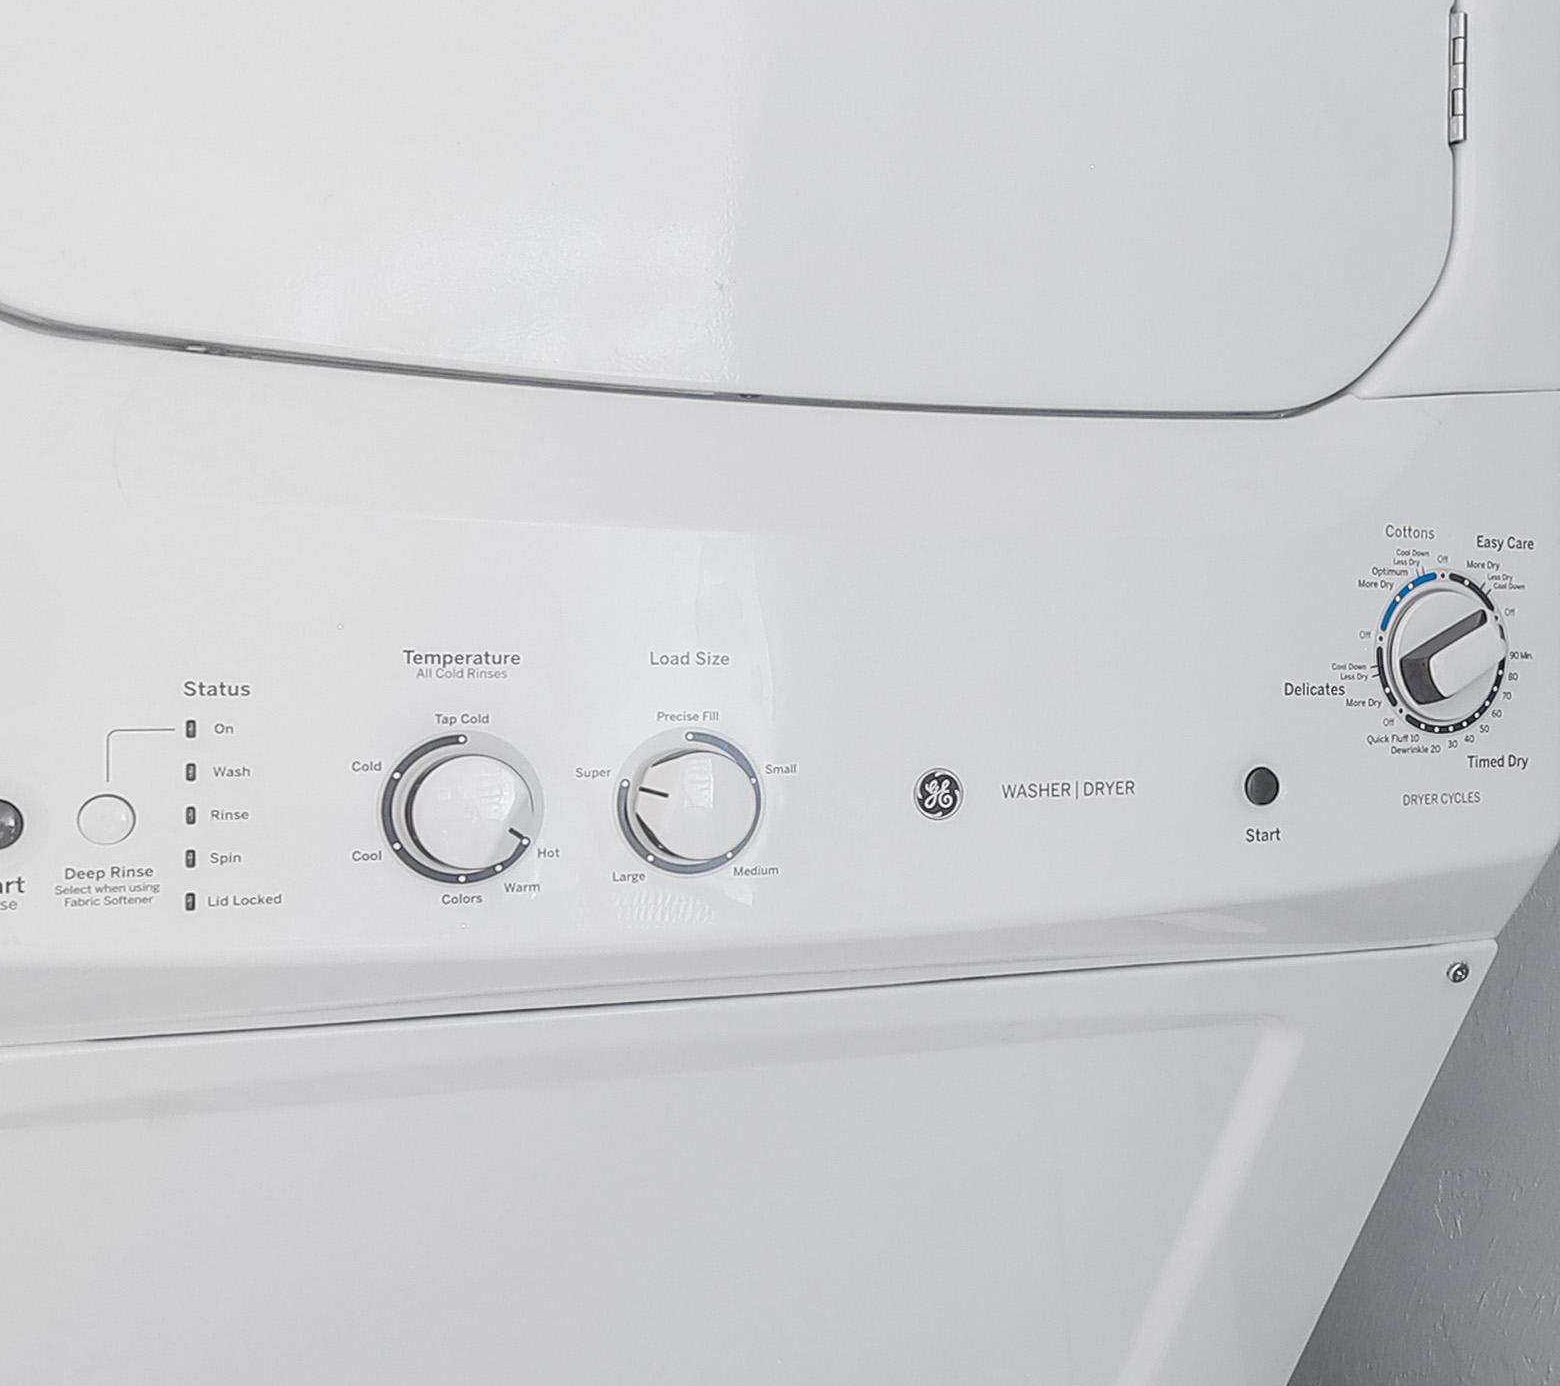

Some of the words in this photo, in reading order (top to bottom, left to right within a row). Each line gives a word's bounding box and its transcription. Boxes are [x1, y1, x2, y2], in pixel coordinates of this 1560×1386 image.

[1385, 525, 1434, 540] Cottons
[1477, 536, 1505, 551] Easy
[1507, 536, 1534, 550] Care
[403, 650, 521, 667] Temperature
[650, 651, 679, 665] Load
[695, 651, 730, 666] Size
[1510, 651, 1519, 659] 90
[416, 668, 432, 679] All
[435, 668, 465, 679] Cold
[467, 668, 508, 679] Rinses
[1508, 672, 1518, 681] 80
[183, 681, 251, 696] Status
[1284, 683, 1345, 697] Delicates
[1502, 692, 1512, 700] 70
[435, 713, 456, 726] Tap
[459, 713, 490, 725] Cold
[657, 711, 700, 722] Precise
[703, 711, 719, 722] Fill
[1491, 709, 1502, 718] 60
[214, 724, 234, 734] On
[1480, 725, 1489, 733] 50
[1448, 740, 1458, 748] 30
[1464, 735, 1475, 743] 40
[352, 761, 382, 772] Cold
[766, 763, 797, 774] Small
[1467, 755, 1504, 768] Timed
[1508, 755, 1528, 770] Dry
[212, 766, 250, 777] Wash
[575, 767, 612, 780] Super
[1002, 783, 1070, 799] WASHER
[1083, 780, 1135, 797] DRYER
[1403, 794, 1438, 806] DRYER
[1441, 792, 1481, 805] CYCLES
[211, 810, 249, 821] Rinse
[1246, 827, 1281, 843] Start
[352, 851, 382, 862] Cool
[537, 847, 559, 858] Hot
[210, 853, 241, 865] Spin
[65, 867, 105, 881] Deep
[111, 866, 153, 878] Rinse
[613, 870, 645, 883] Large
[734, 865, 779, 877] Medium
[55, 884, 92, 895] Select
[95, 884, 126, 893] when
[128, 883, 160, 895] using
[504, 881, 540, 893] Warm
[64, 896, 100, 907] Fabric
[103, 895, 153, 906] Softener
[208, 895, 229, 907] Lid
[233, 893, 282, 906] Locked
[441, 893, 482, 905] Colors
